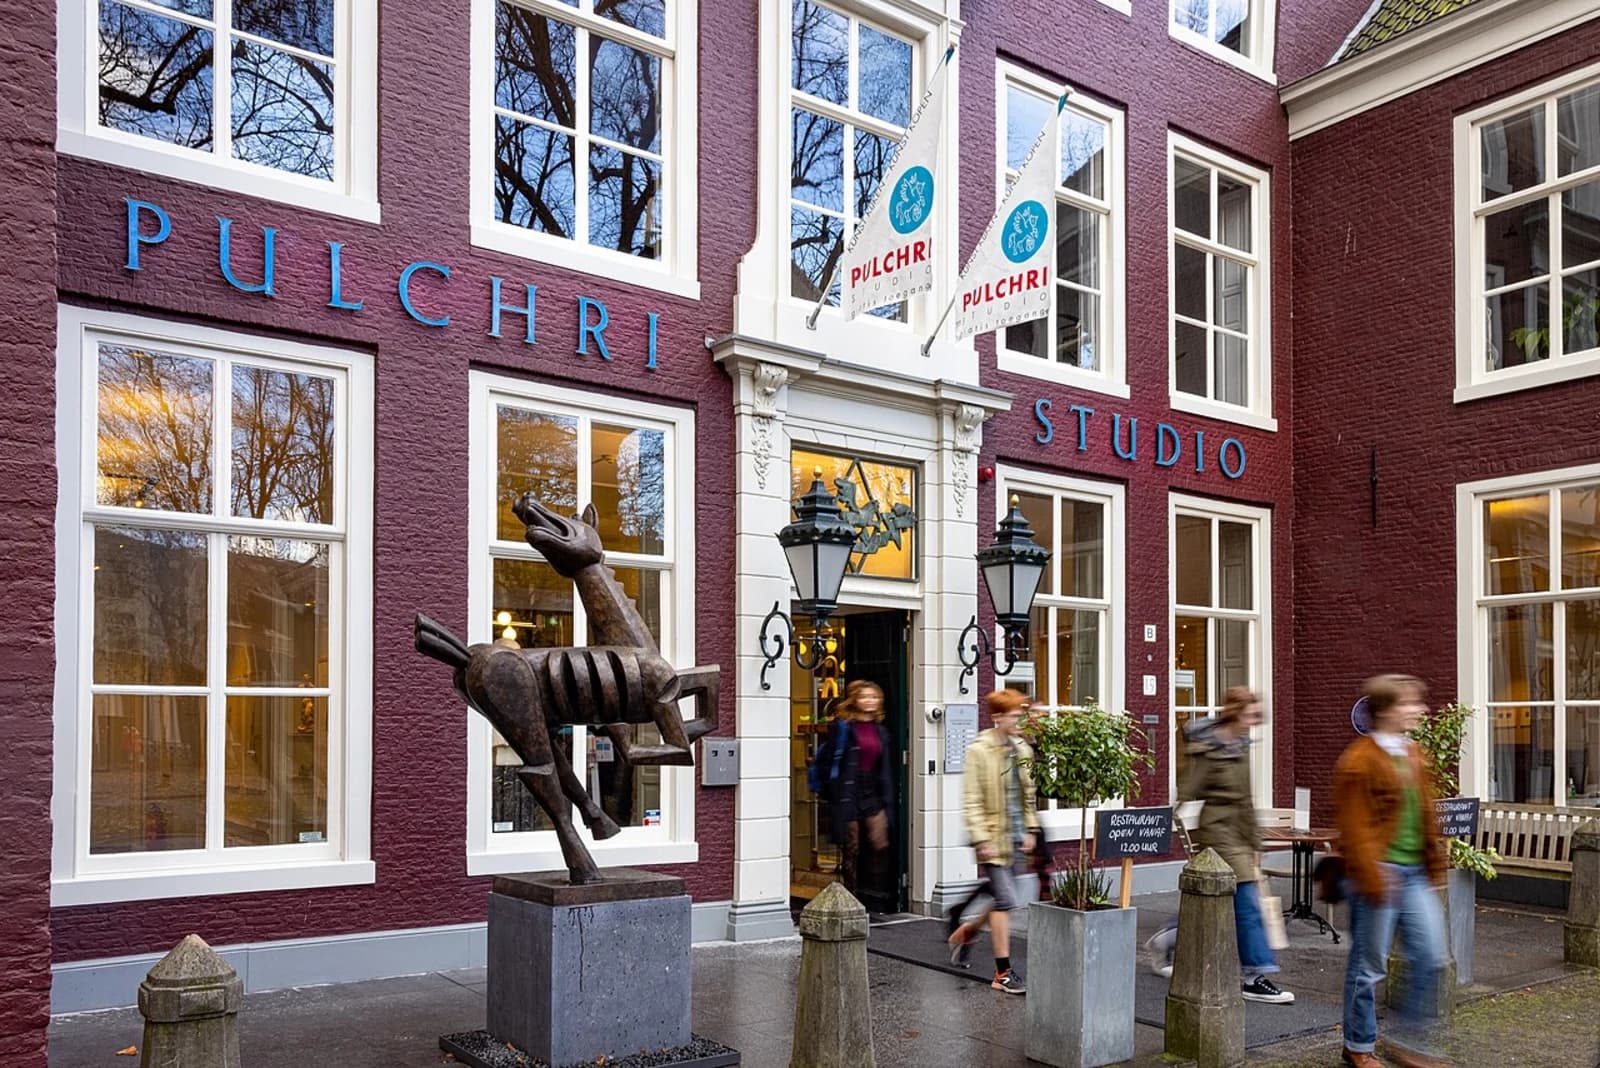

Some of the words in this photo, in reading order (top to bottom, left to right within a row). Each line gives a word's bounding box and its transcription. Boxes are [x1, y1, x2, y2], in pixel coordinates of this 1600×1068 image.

[909, 90, 933, 132] KOPEN
[850, 237, 932, 289] PULCHRI
[962, 266, 1048, 313] PULCHRI
[122, 196, 661, 370] PULCHRI
[1034, 398, 1247, 480] STUDIO
[1146, 627, 1154, 639] B
[1110, 813, 1163, 827] RESTAURANT
[1138, 827, 1167, 838] VANAF
[1141, 841, 1159, 853] UUR
